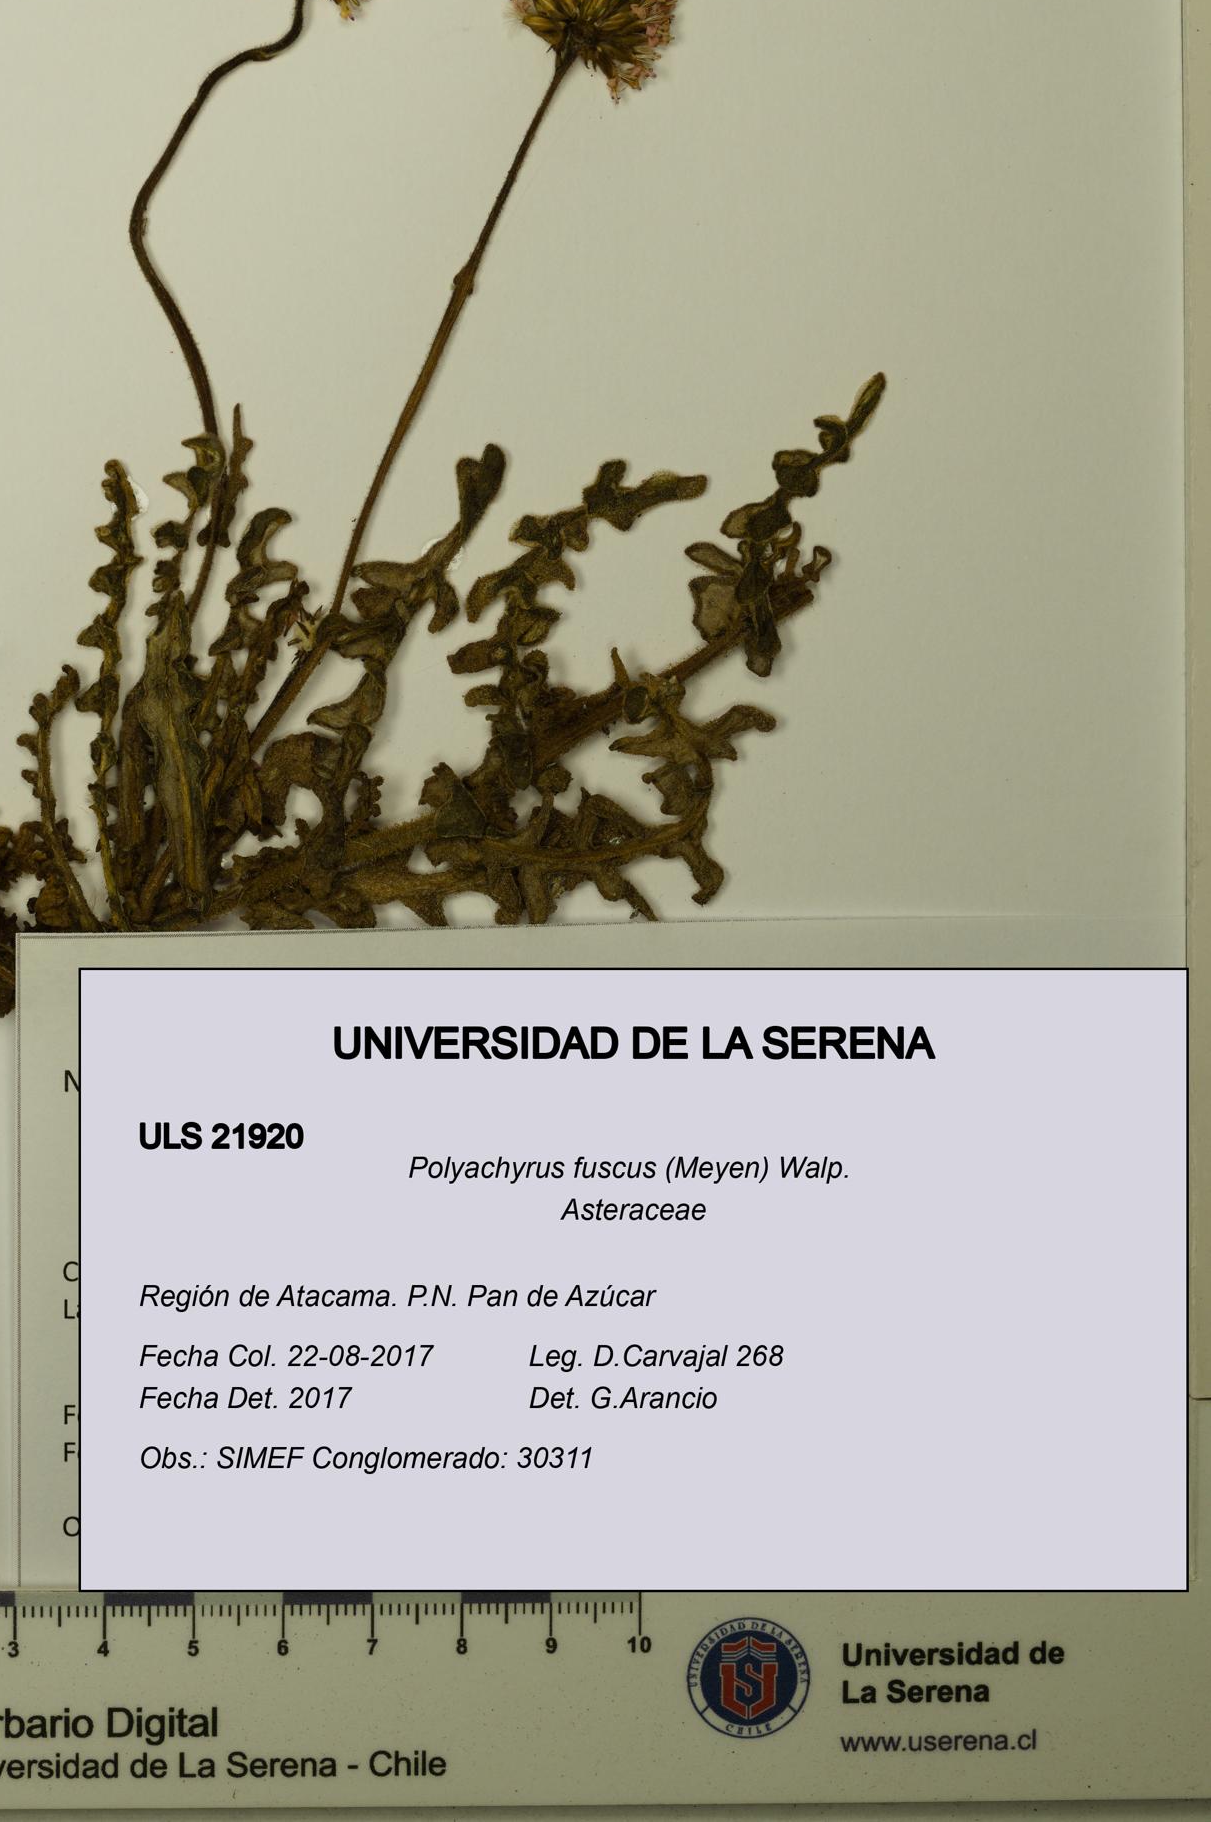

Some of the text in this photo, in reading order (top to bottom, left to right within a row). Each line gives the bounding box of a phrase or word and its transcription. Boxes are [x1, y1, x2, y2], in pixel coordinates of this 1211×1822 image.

[8, 1642, 19, 1658] 3
[97, 1641, 109, 1658] 4
[187, 1641, 199, 1657] 5
[277, 1640, 289, 1657] 6
[367, 1639, 378, 1655] 7
[456, 1639, 468, 1655] 8
[545, 1638, 557, 1654] 9
[627, 1637, 652, 1653] 10
[842, 1640, 1065, 1668] Universidad de
[842, 1679, 989, 1704] La Serena
[106, 1707, 219, 1746] Digital
[840, 1728, 1037, 1753] www.userena.cl
[129, 1752, 168, 1779] de
[179, 1752, 216, 1779] La
[226, 1751, 337, 1779] Serena
[369, 1749, 447, 1778] Chile
